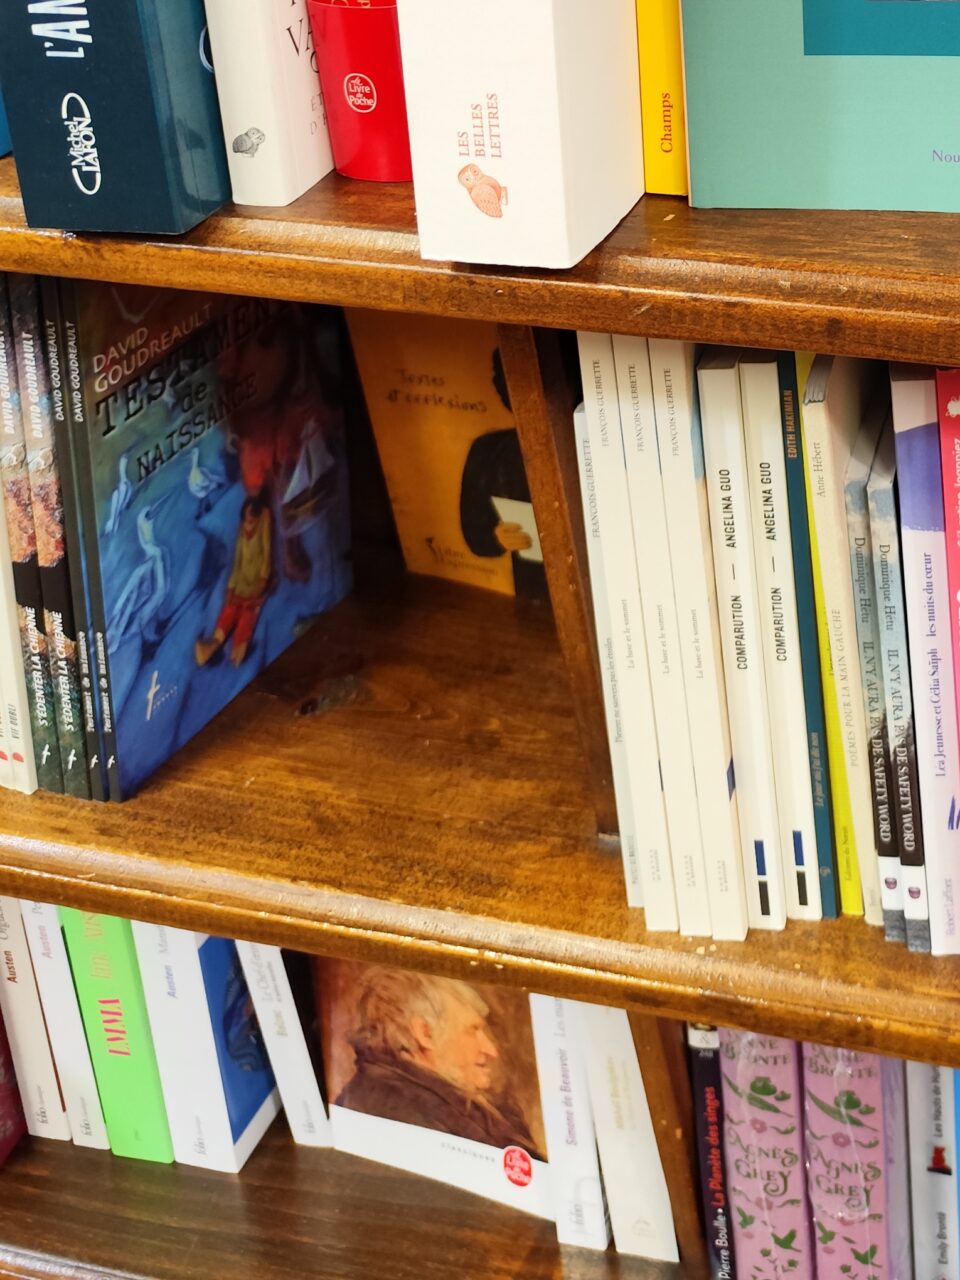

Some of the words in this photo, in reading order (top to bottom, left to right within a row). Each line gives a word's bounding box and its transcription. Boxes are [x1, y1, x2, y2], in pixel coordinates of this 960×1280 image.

[349, 83, 371, 93] Livre
[349, 95, 375, 105] Poche
[65, 120, 85, 167] Michel
[457, 130, 470, 157] LES
[472, 103, 486, 158] BELLES
[488, 92, 502, 159] LETTRES
[660, 91, 673, 153] Champs
[22, 331, 38, 404] GOUDREAULT
[46, 320, 61, 387] GOUDREAULT
[66, 321, 81, 390] GOUDREAULT
[93, 327, 149, 374] DAVID
[94, 303, 212, 393] GOUDREAULT
[31, 405, 43, 438] DAVID
[53, 391, 64, 421] DAVID
[71, 392, 83, 422] DAVID
[137, 373, 257, 482] NAISSANCE
[719, 468, 732, 491] GUO
[760, 462, 771, 484] GUO
[720, 496, 737, 549] ANGELINA
[763, 489, 777, 541] ANGELINA
[731, 594, 748, 670] COMPARUTION
[773, 586, 788, 662] COMPARUTION
[4, 951, 18, 984] Austen
[705, 1087, 720, 1133] singes
[706, 1135, 719, 1152] des
[708, 1156, 723, 1196] Planète
[711, 1198, 724, 1206] La
[713, 1214, 729, 1244] Boulle
[718, 1245, 732, 1279] Pierre
